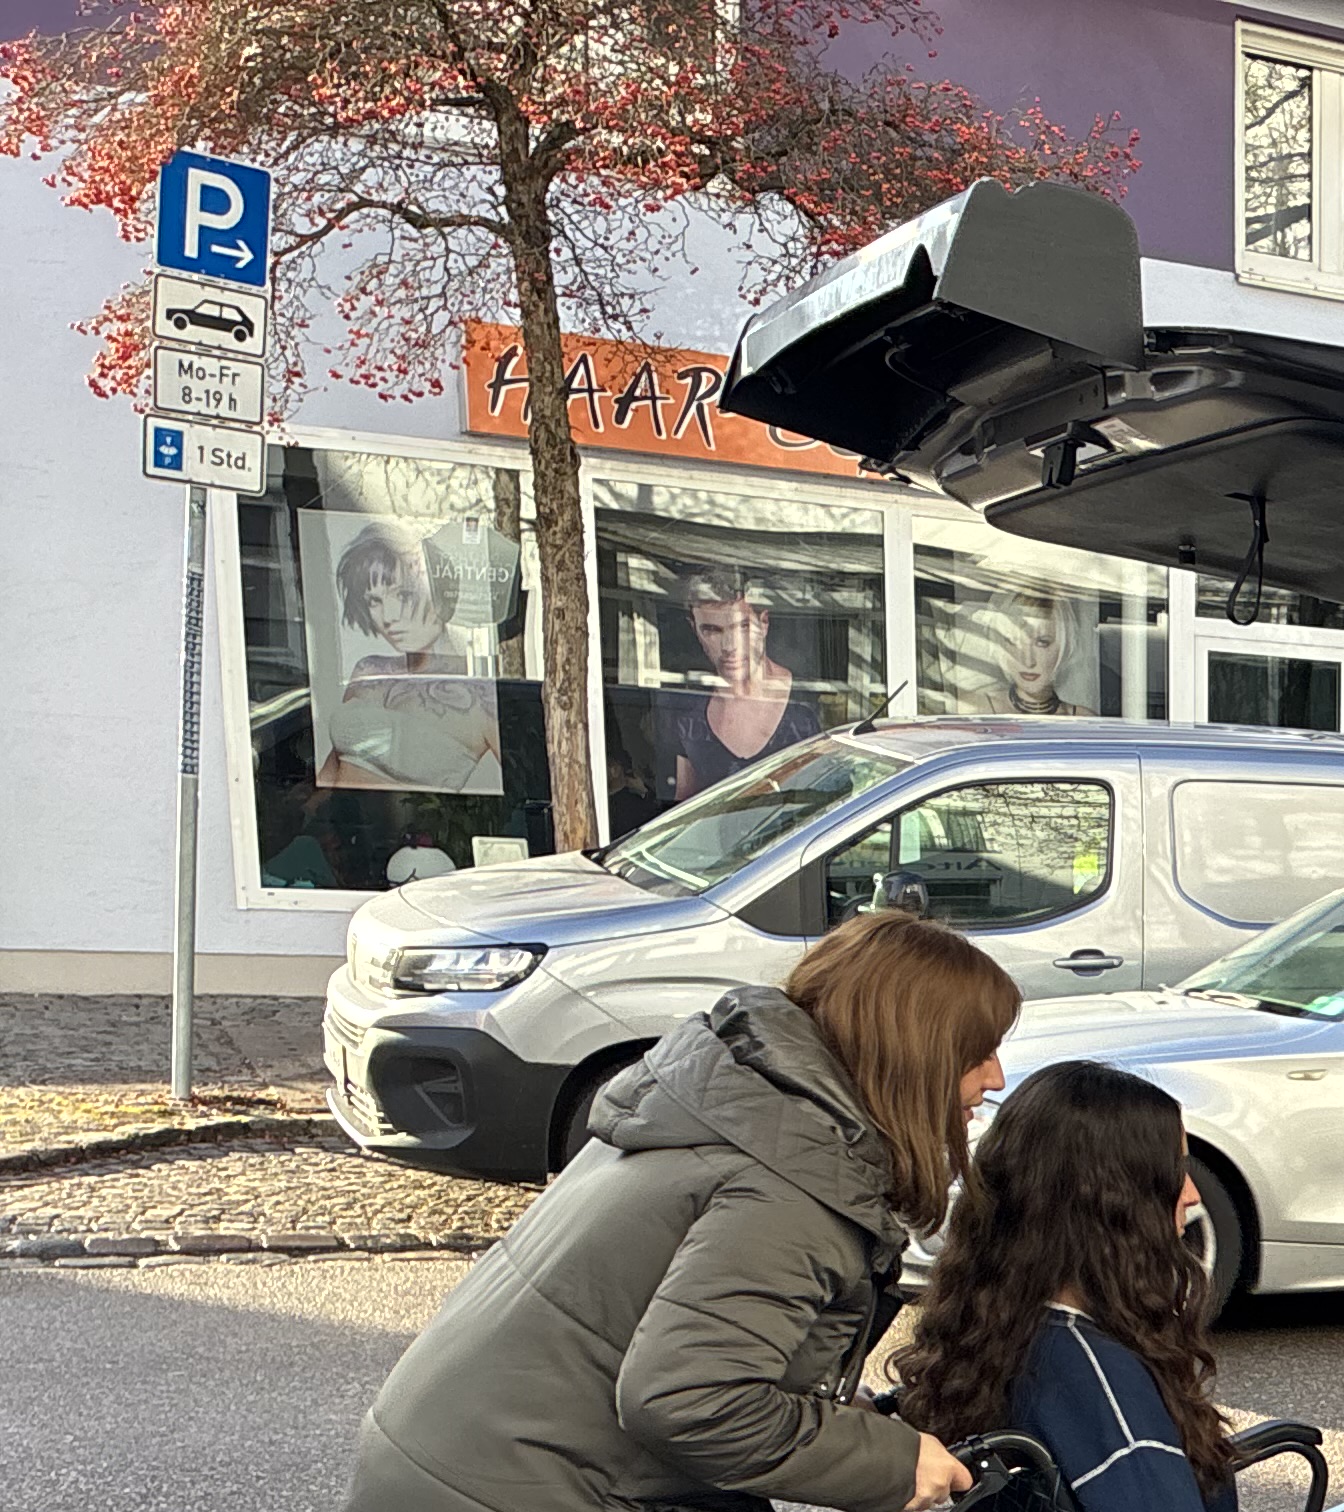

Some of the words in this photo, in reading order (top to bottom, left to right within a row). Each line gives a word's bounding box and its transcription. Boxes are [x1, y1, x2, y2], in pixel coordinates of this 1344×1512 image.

[184, 167, 244, 259] P
[178, 360, 240, 386] Mo-Fr
[181, 386, 222, 408] 8-19
[198, 446, 204, 464] 1
[211, 449, 251, 472] Std.
